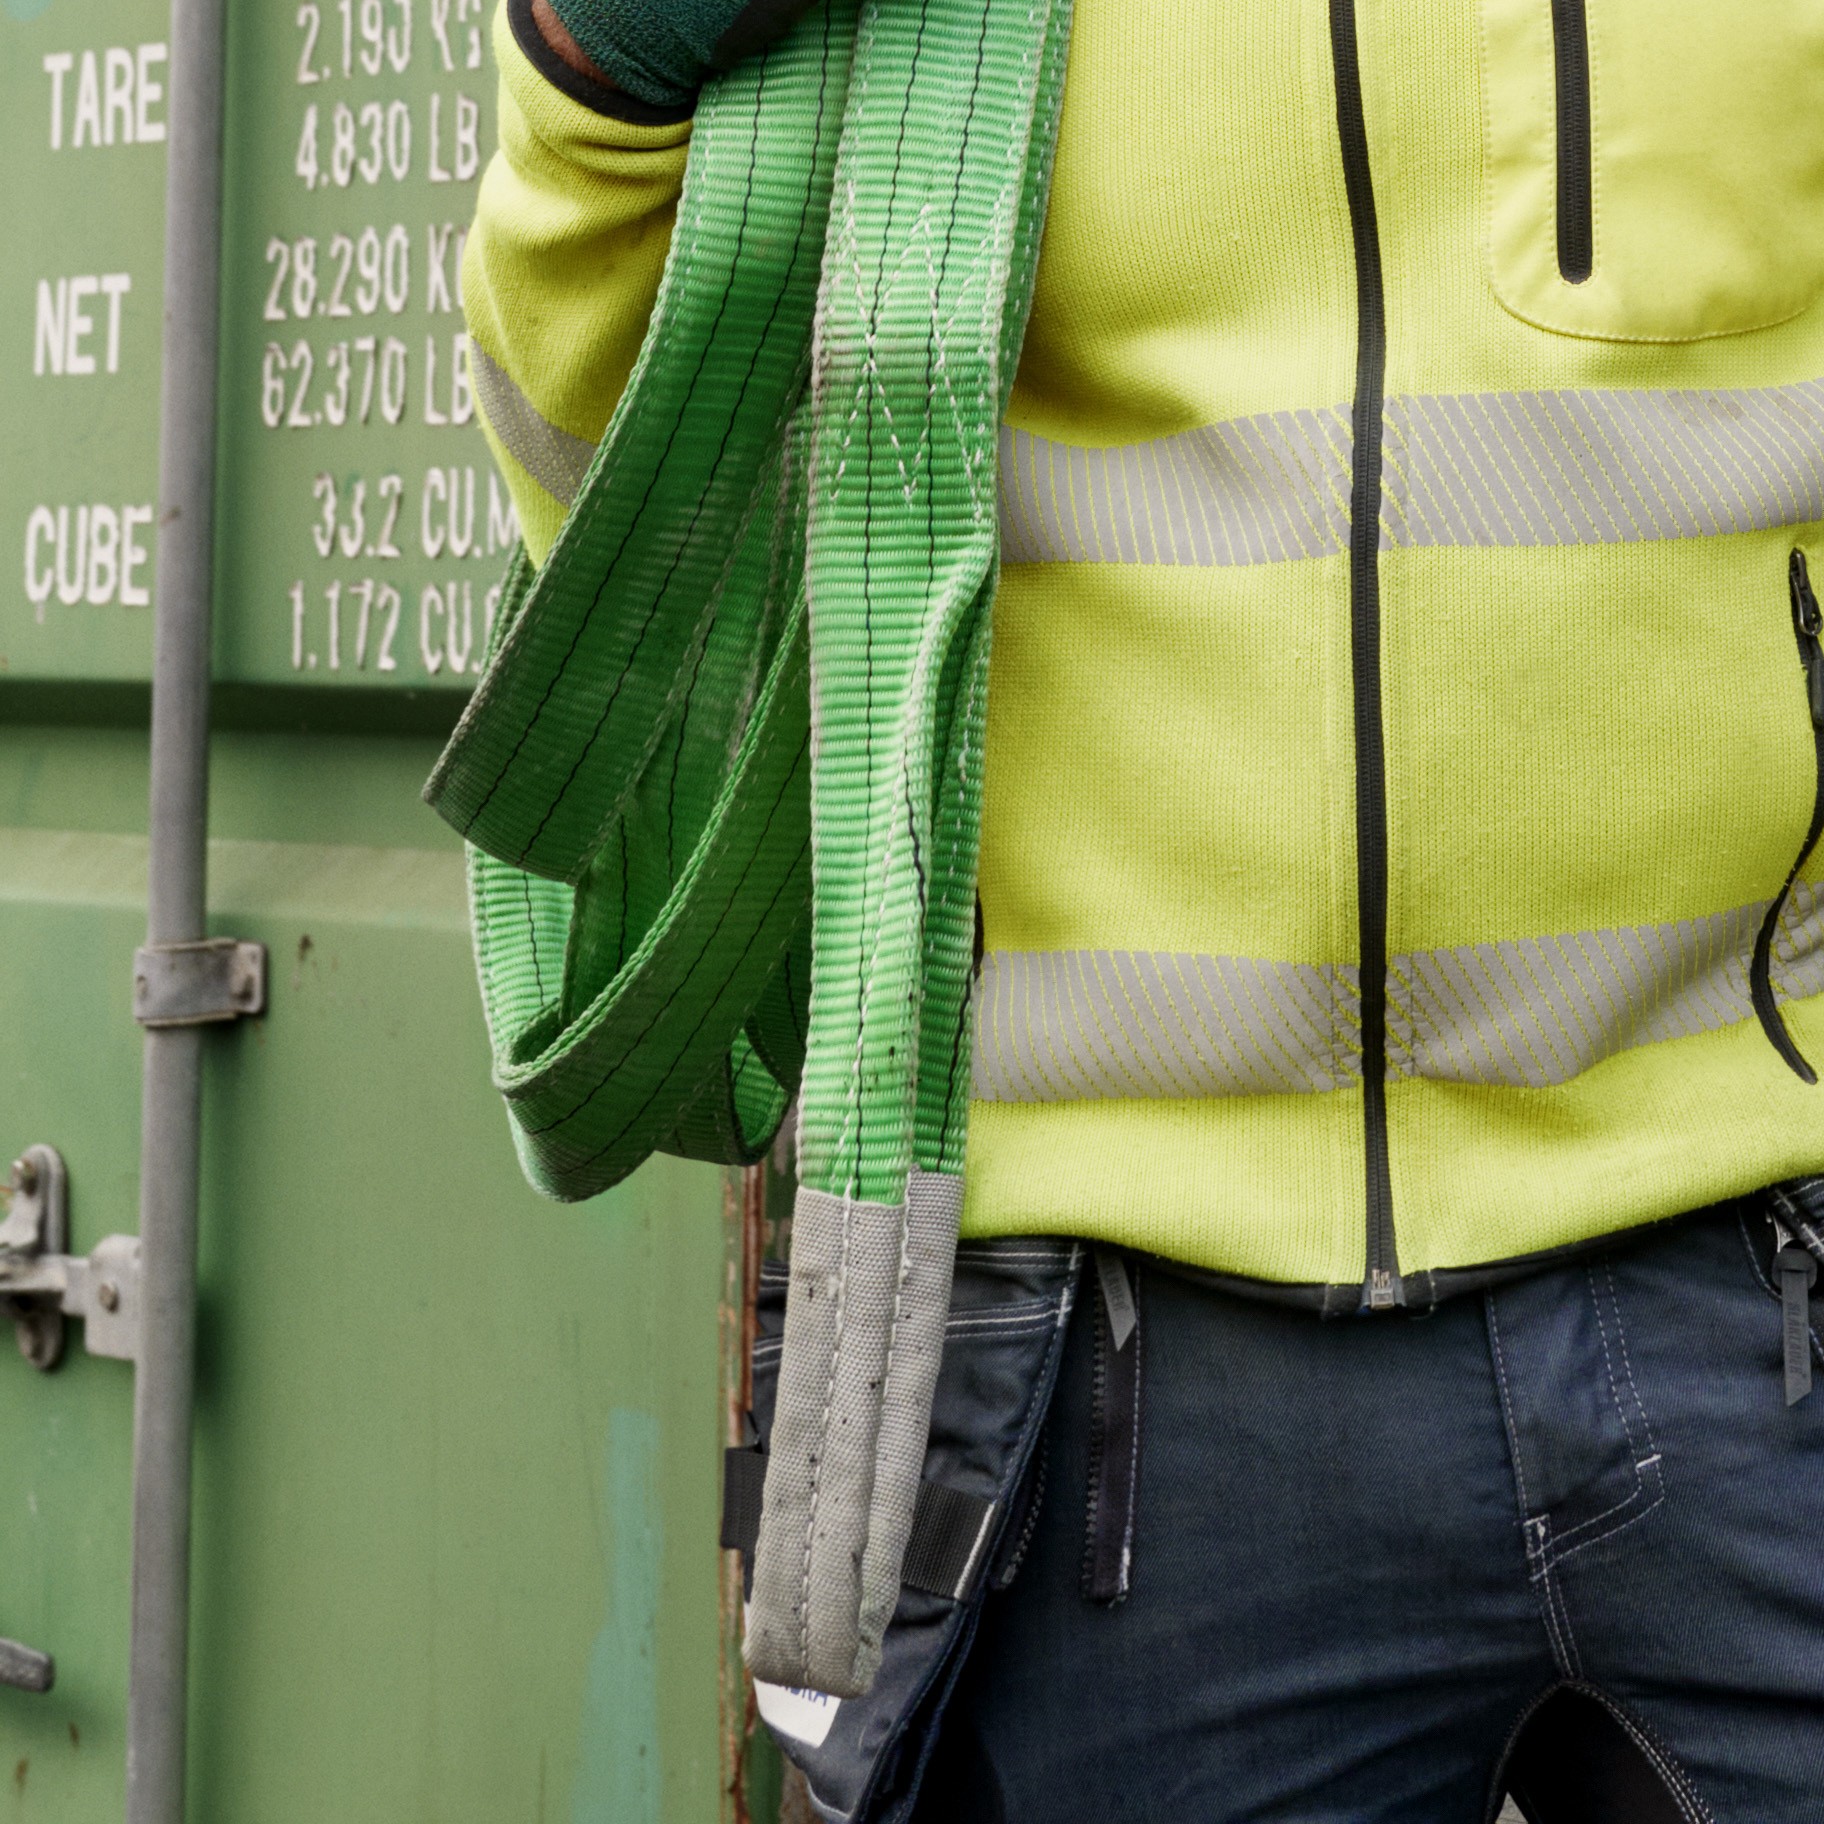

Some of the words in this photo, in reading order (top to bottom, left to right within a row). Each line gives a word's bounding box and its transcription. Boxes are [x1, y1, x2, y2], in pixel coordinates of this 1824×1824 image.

[44, 44, 166, 149] TARE
[296, 100, 411, 190] 4.830
[429, 93, 478, 182] LB
[264, 224, 410, 321] 28.290
[35, 274, 130, 375] NET
[261, 340, 406, 428] 62.370
[425, 334, 474, 426] LB
[25, 505, 152, 606] CUBE
[313, 473, 402, 559] 33.2
[289, 582, 401, 671] 1.172
